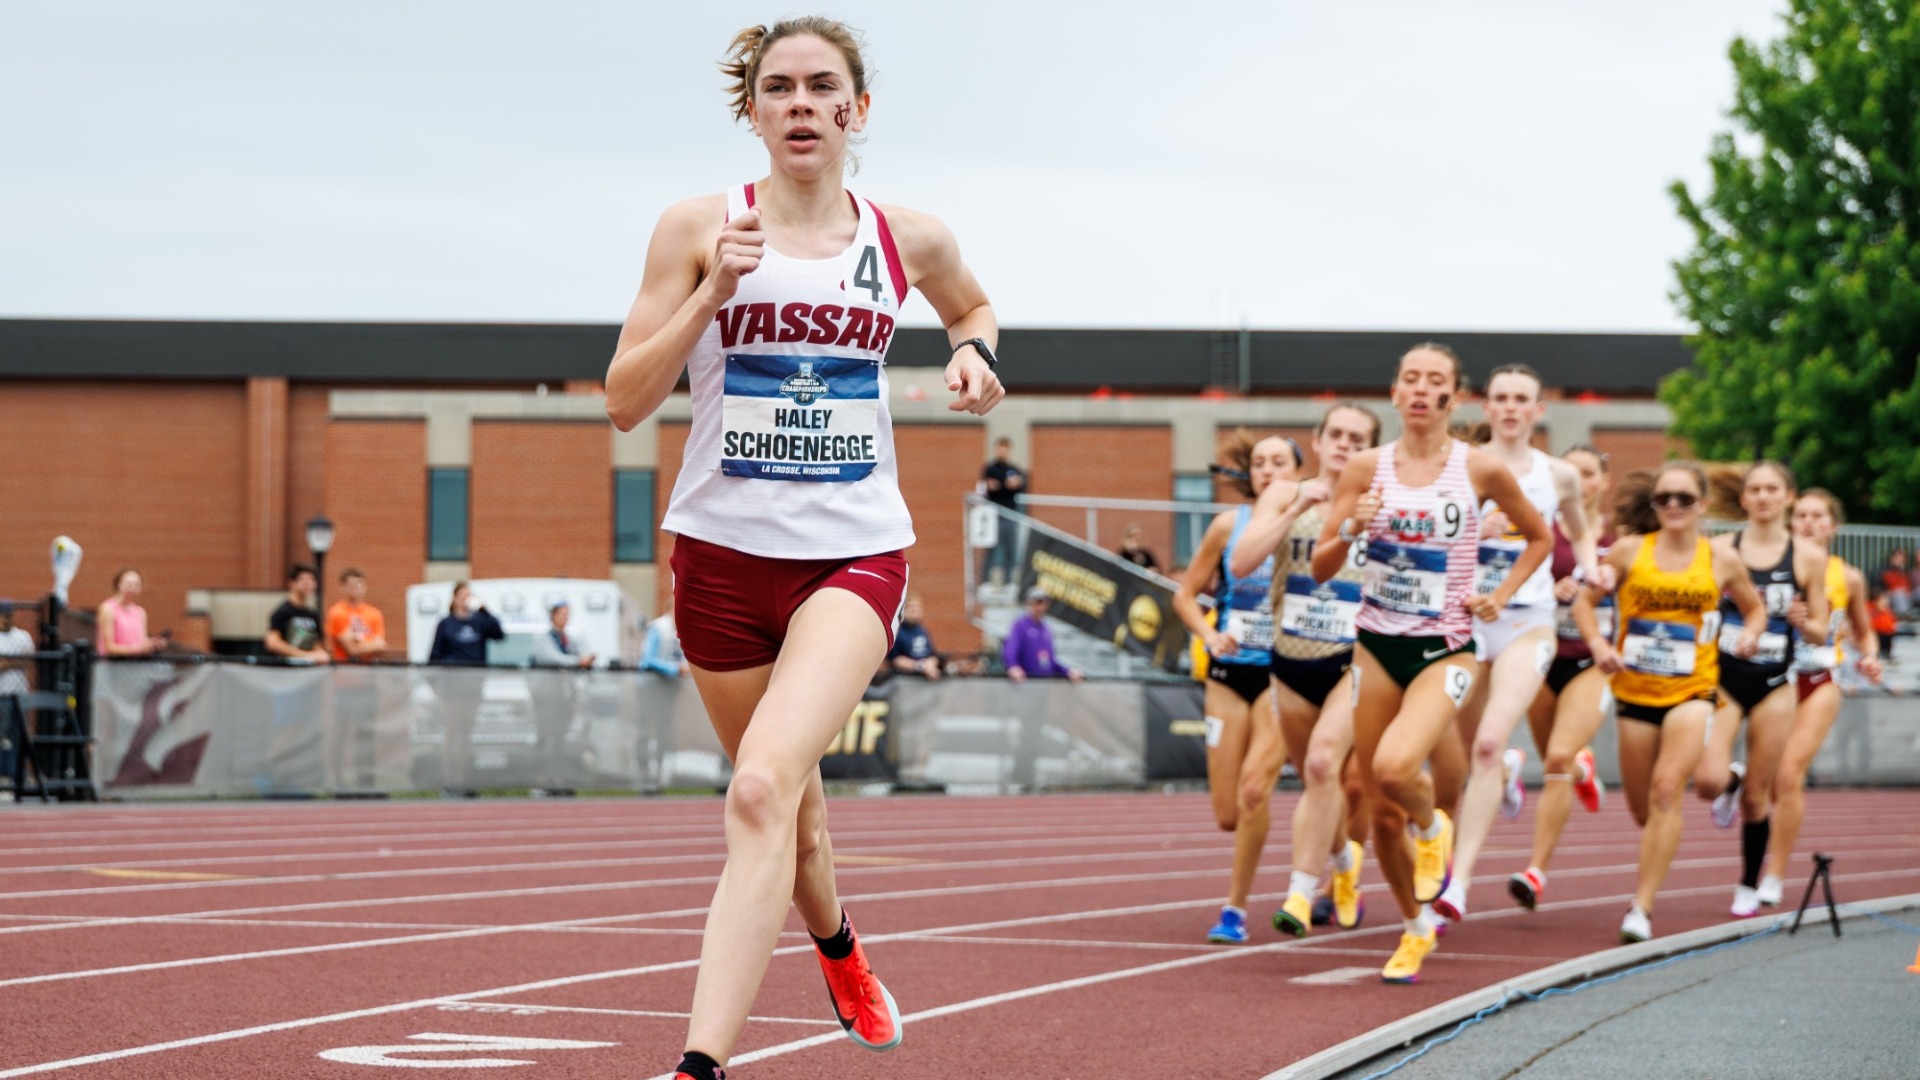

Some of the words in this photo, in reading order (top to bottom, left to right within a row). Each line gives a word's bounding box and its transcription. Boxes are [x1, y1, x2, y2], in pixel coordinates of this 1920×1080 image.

[853, 245, 883, 302] 4
[715, 302, 895, 354] VASSAR
[781, 385, 827, 393] CHAMPIONSHIPS
[775, 408, 833, 429] HALEY
[723, 430, 875, 462] SCHOENEGGE
[761, 465, 770, 473] LA
[802, 467, 840, 475] WISCONSIN
[1445, 503, 1461, 538] 9
[1355, 537, 1369, 567] 8
[1454, 671, 1467, 699] 9
